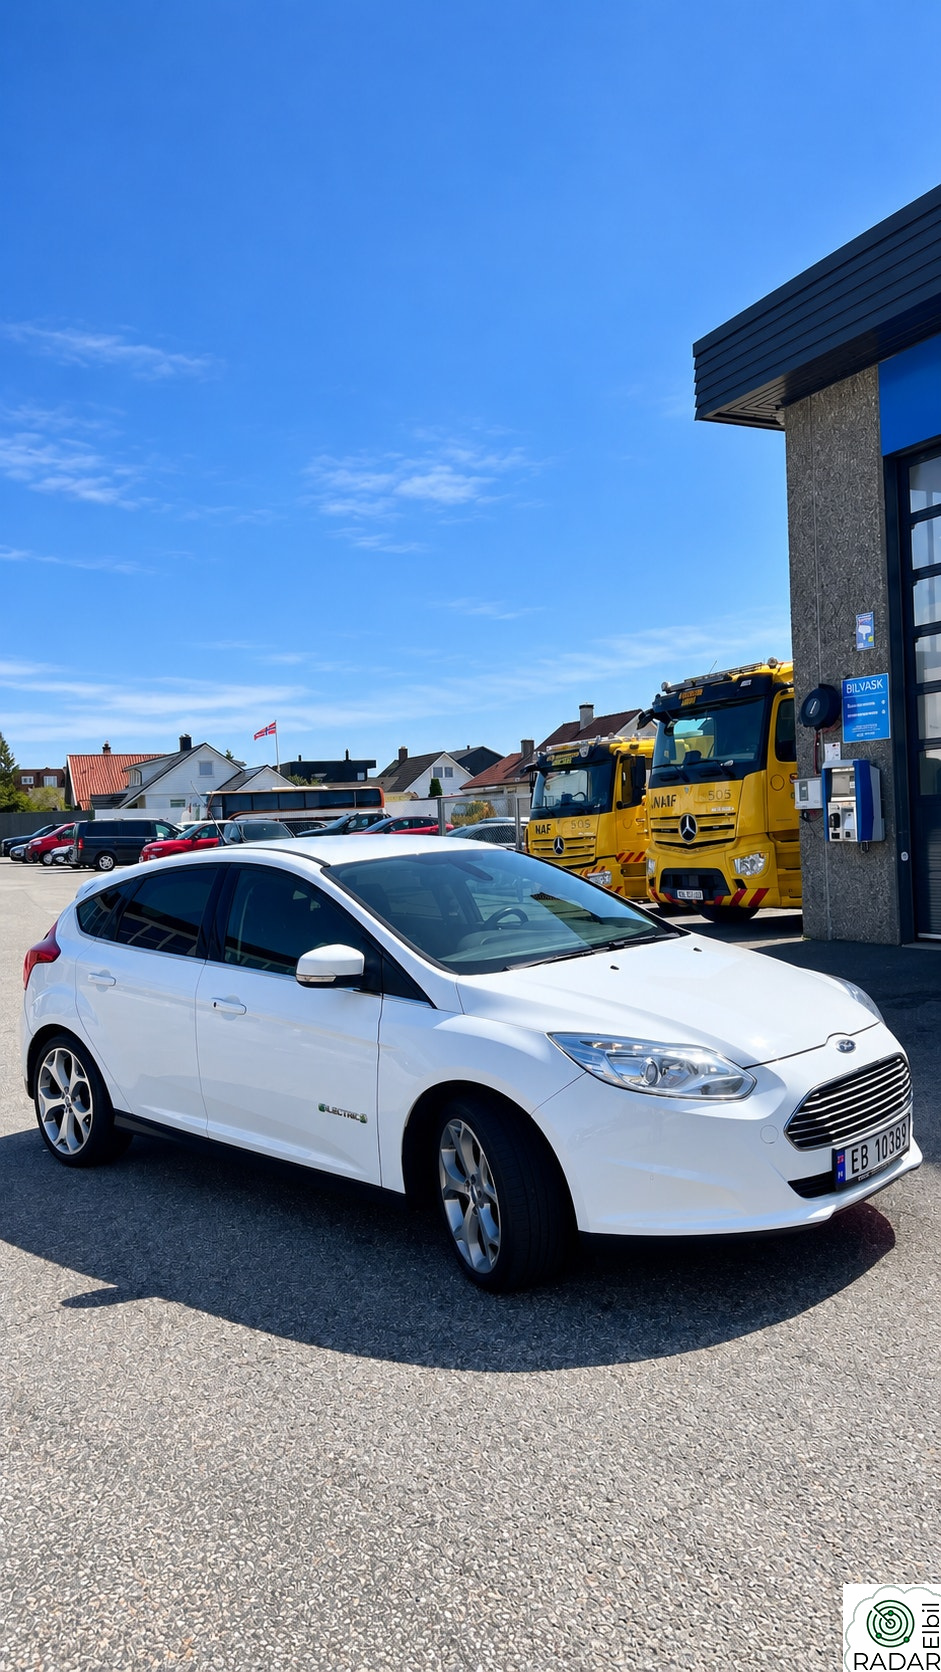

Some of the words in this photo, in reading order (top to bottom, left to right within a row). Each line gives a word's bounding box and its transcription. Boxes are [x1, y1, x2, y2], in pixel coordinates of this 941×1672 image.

[846, 679, 884, 694] BILVASK
[708, 789, 732, 801] 505
[535, 823, 552, 834] NAF
[851, 1144, 869, 1174] EB
[875, 1122, 907, 1162] 10389
